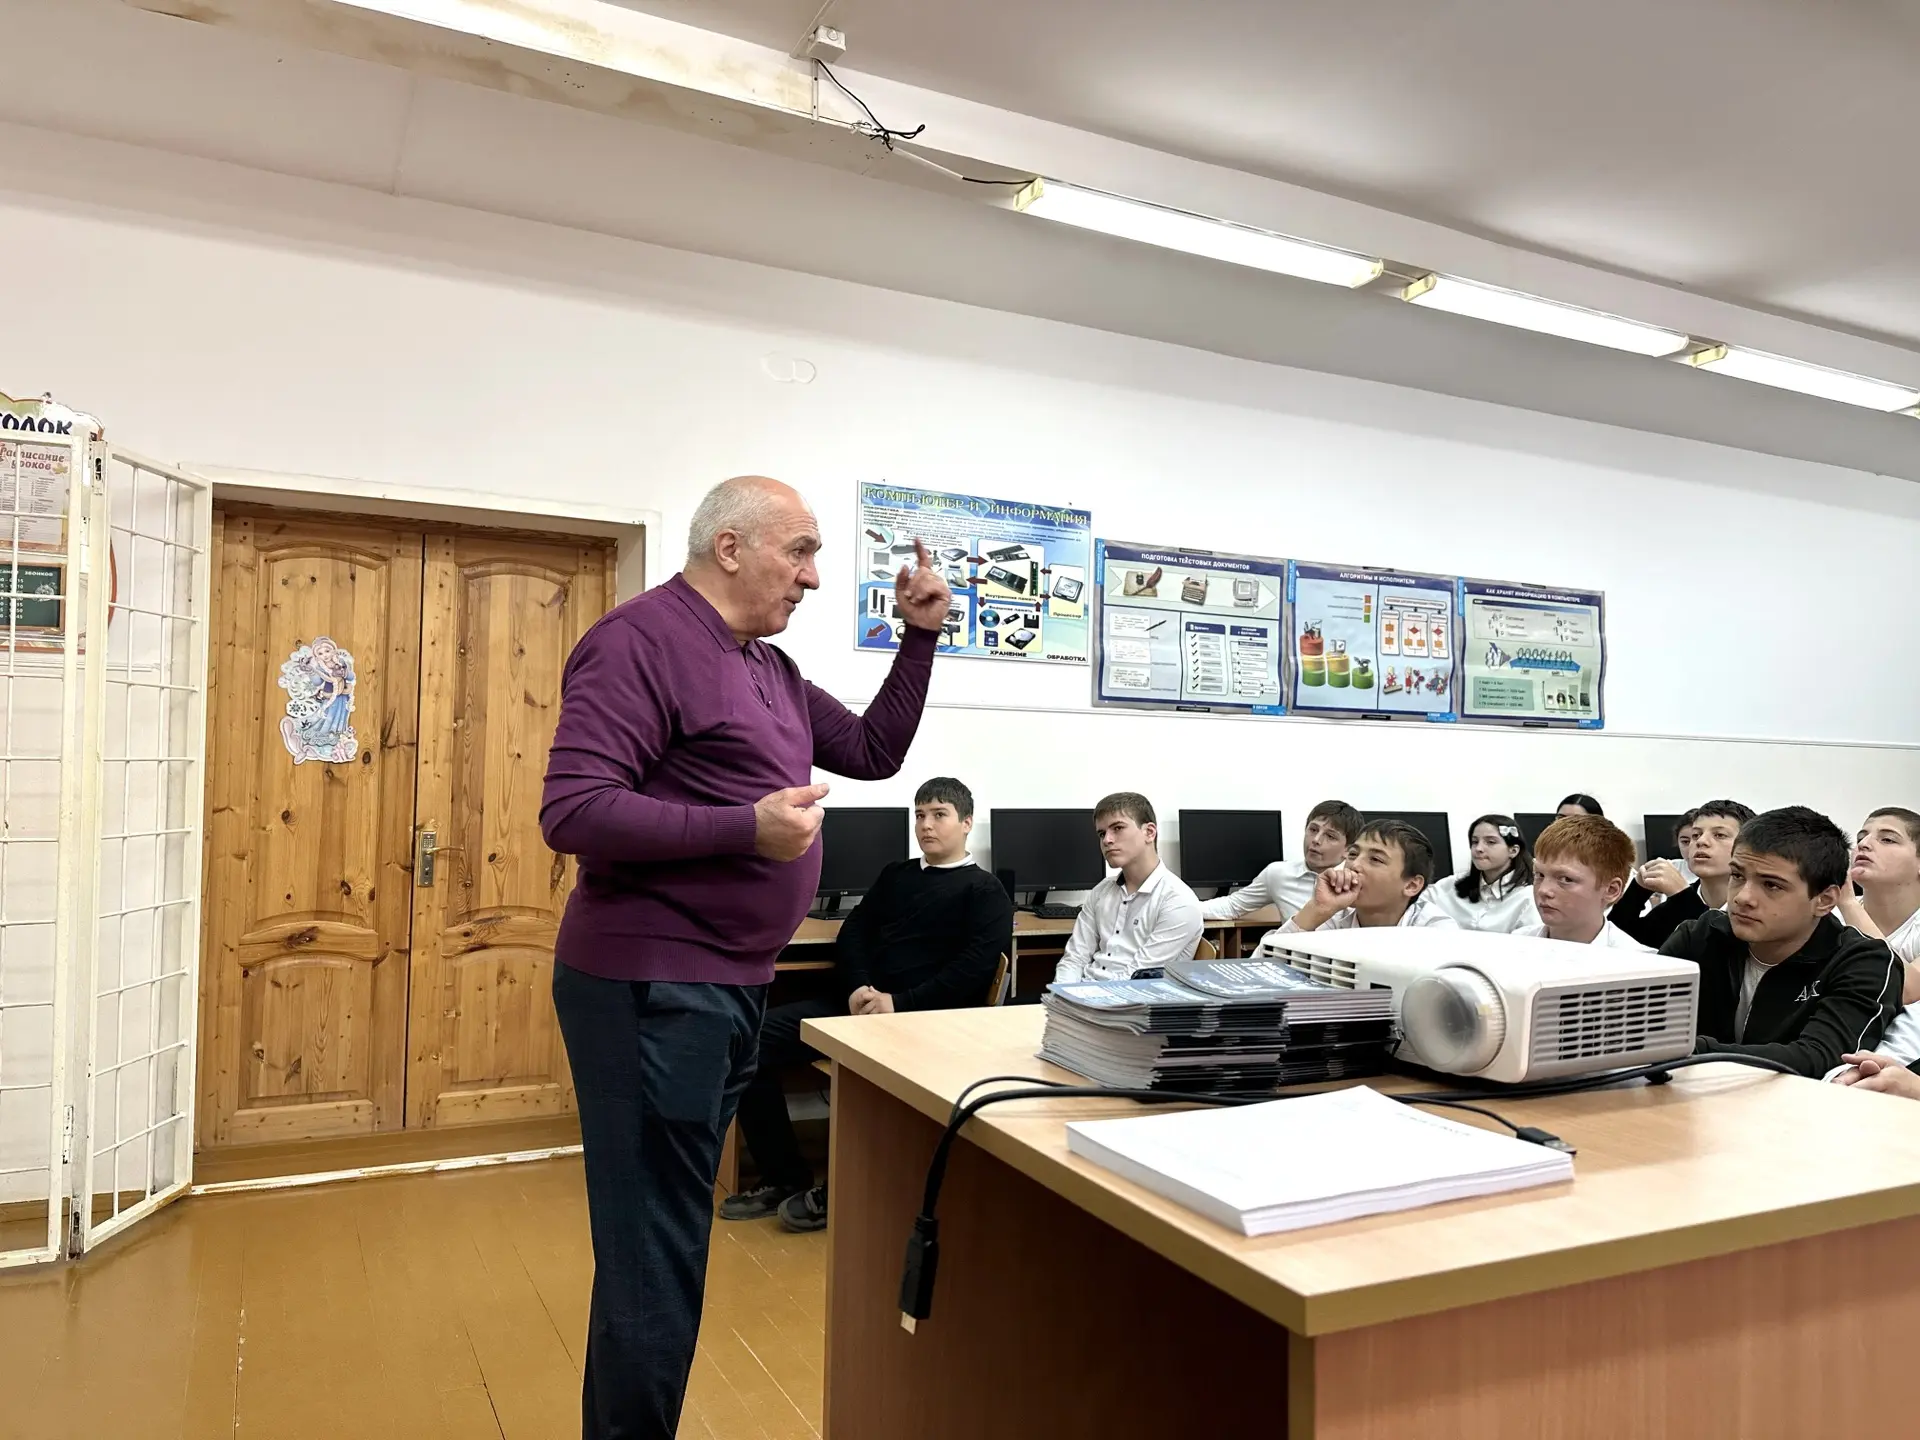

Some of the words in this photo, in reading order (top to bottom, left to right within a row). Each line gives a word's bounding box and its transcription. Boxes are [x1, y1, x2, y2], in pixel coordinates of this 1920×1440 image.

[0, 413, 73, 435] ОЛОК
[865, 487, 964, 509] КОМПЬЮТЕР
[969, 500, 979, 511] И
[990, 504, 1087, 525] ИНФОРМАЦИЯ
[1141, 553, 1178, 563] ПОДГОТОВКА
[1212, 561, 1250, 571] ДОКУМЕНТОВ
[1340, 572, 1373, 581] АЛГОРИТМЫ
[1379, 576, 1416, 584] ИСПОЛНИТЕЛИ
[1047, 654, 1087, 662] ОБРАБОТКА
